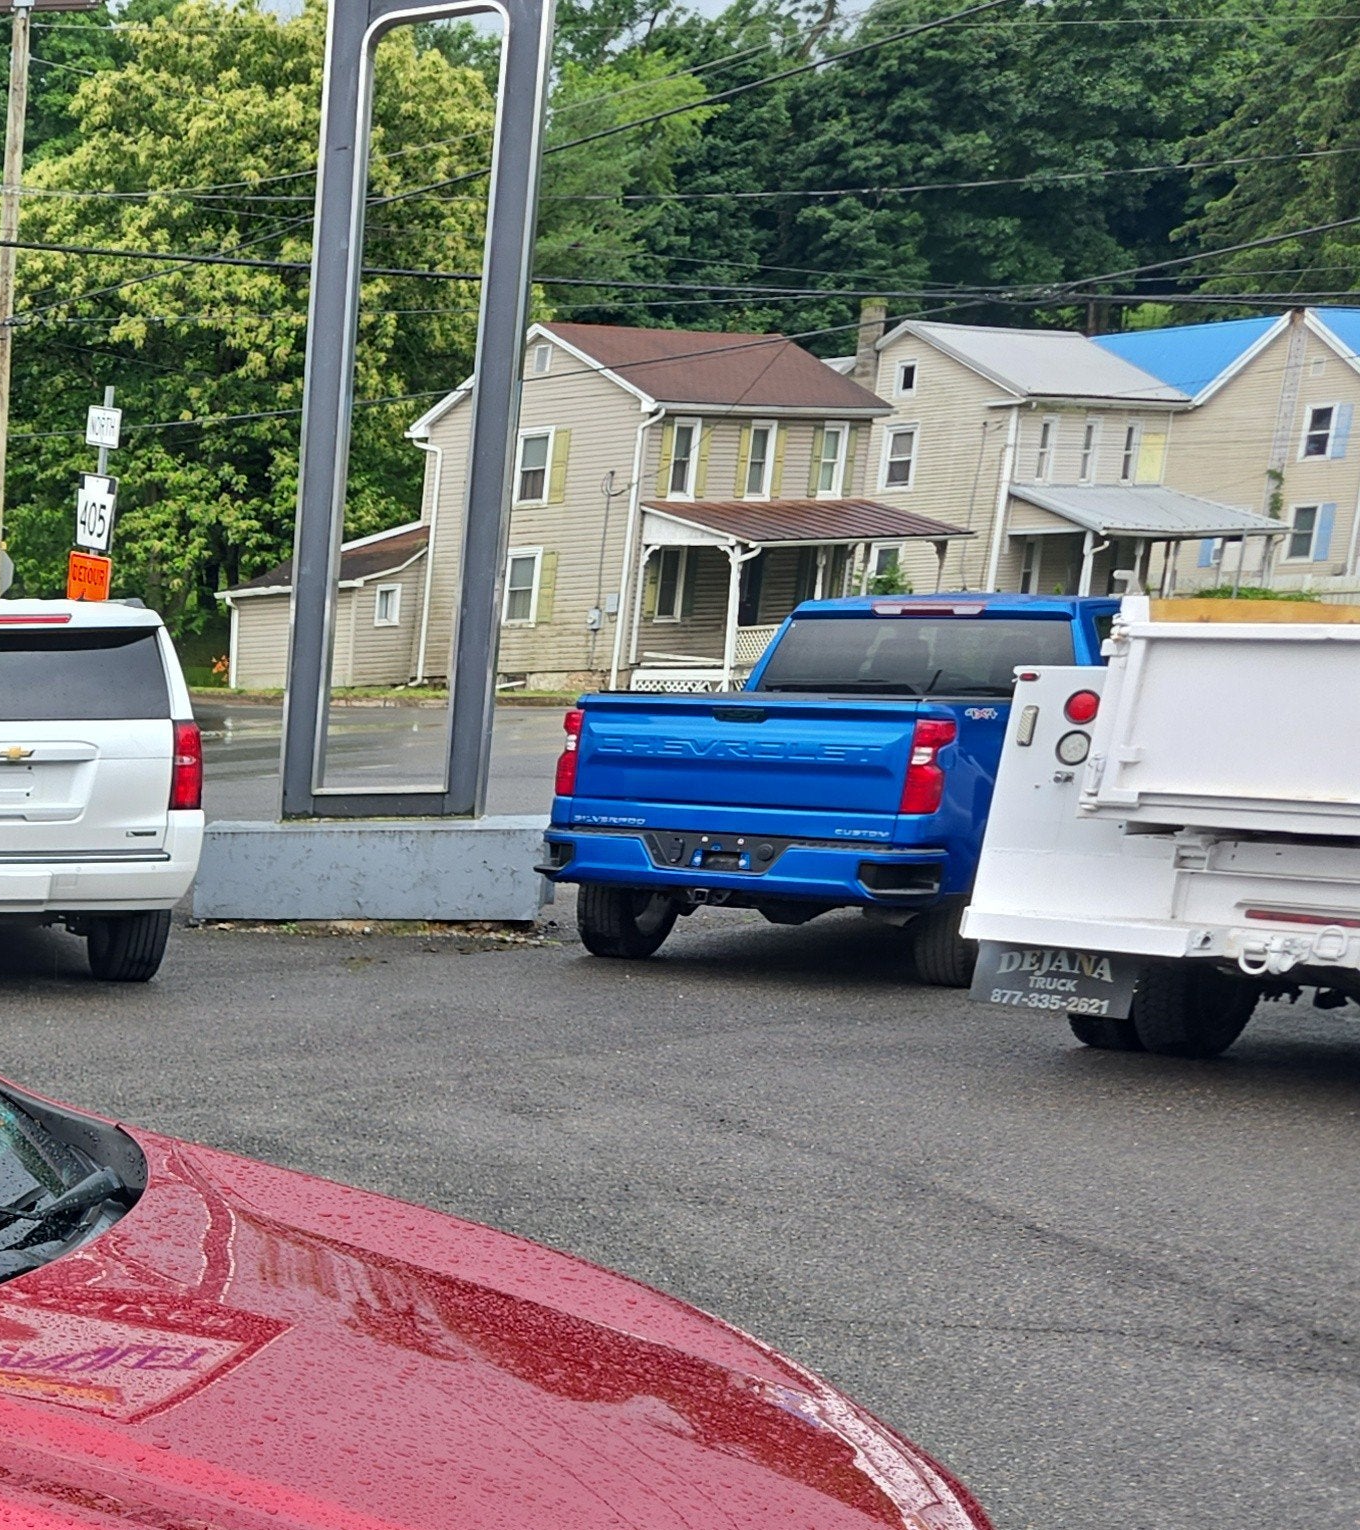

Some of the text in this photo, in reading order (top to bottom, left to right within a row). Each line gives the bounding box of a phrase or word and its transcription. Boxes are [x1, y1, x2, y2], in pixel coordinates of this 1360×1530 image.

[80, 500, 107, 538] 405
[72, 563, 106, 587] DETOUR
[597, 738, 882, 762] CHEVROLET
[834, 828, 890, 838] CUSTOM
[996, 950, 1114, 983] DEJANA
[1028, 976, 1079, 992] TRUCK
[990, 988, 1110, 1015] 877-335-2621
